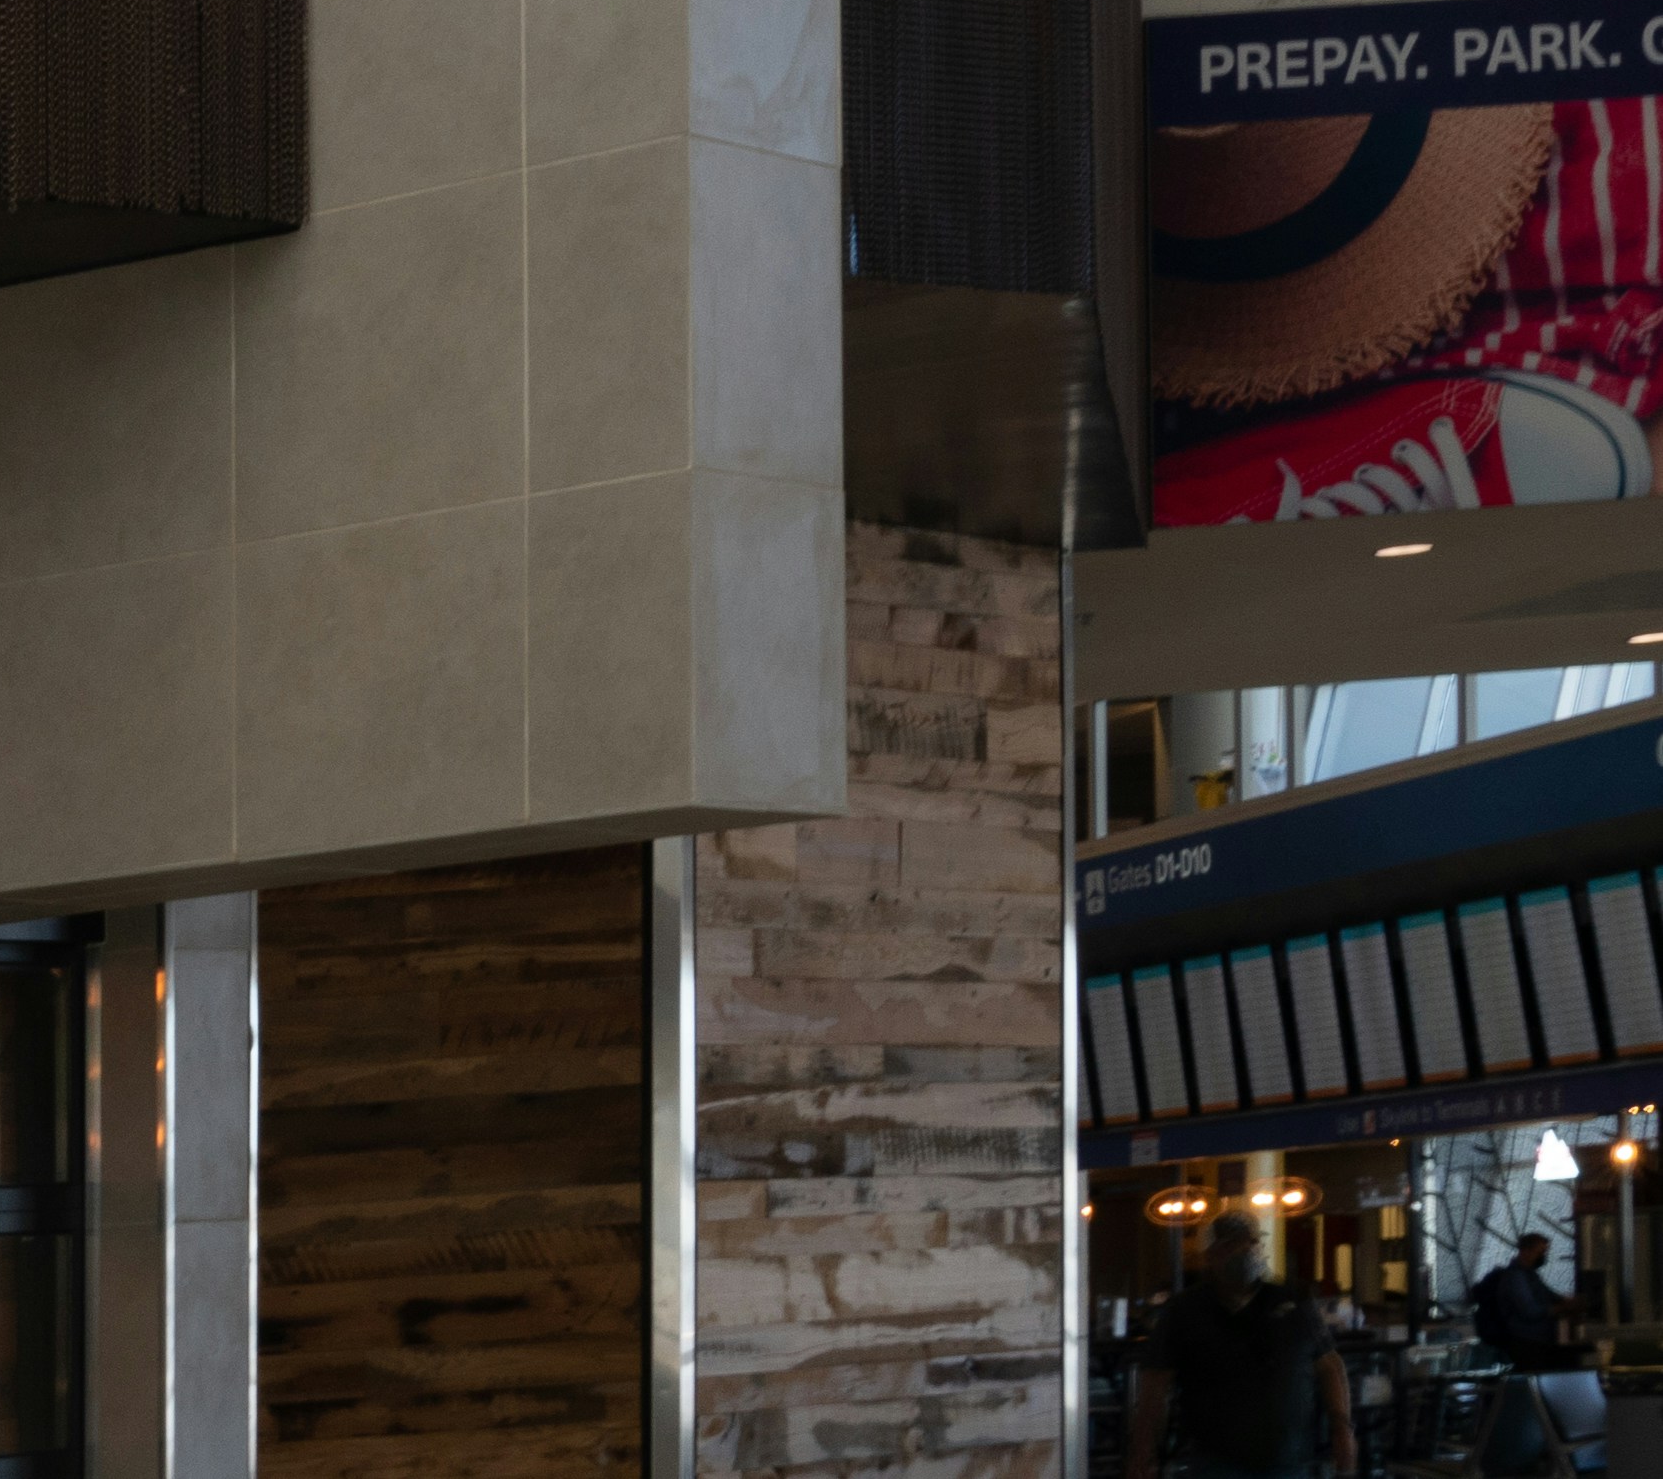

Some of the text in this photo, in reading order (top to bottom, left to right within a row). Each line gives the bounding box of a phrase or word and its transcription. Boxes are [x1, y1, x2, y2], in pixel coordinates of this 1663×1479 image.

[1199, 31, 1428, 93] PREPAY.
[1453, 19, 1622, 78] PARK.
[1107, 842, 1212, 894] Gates D1-D10
